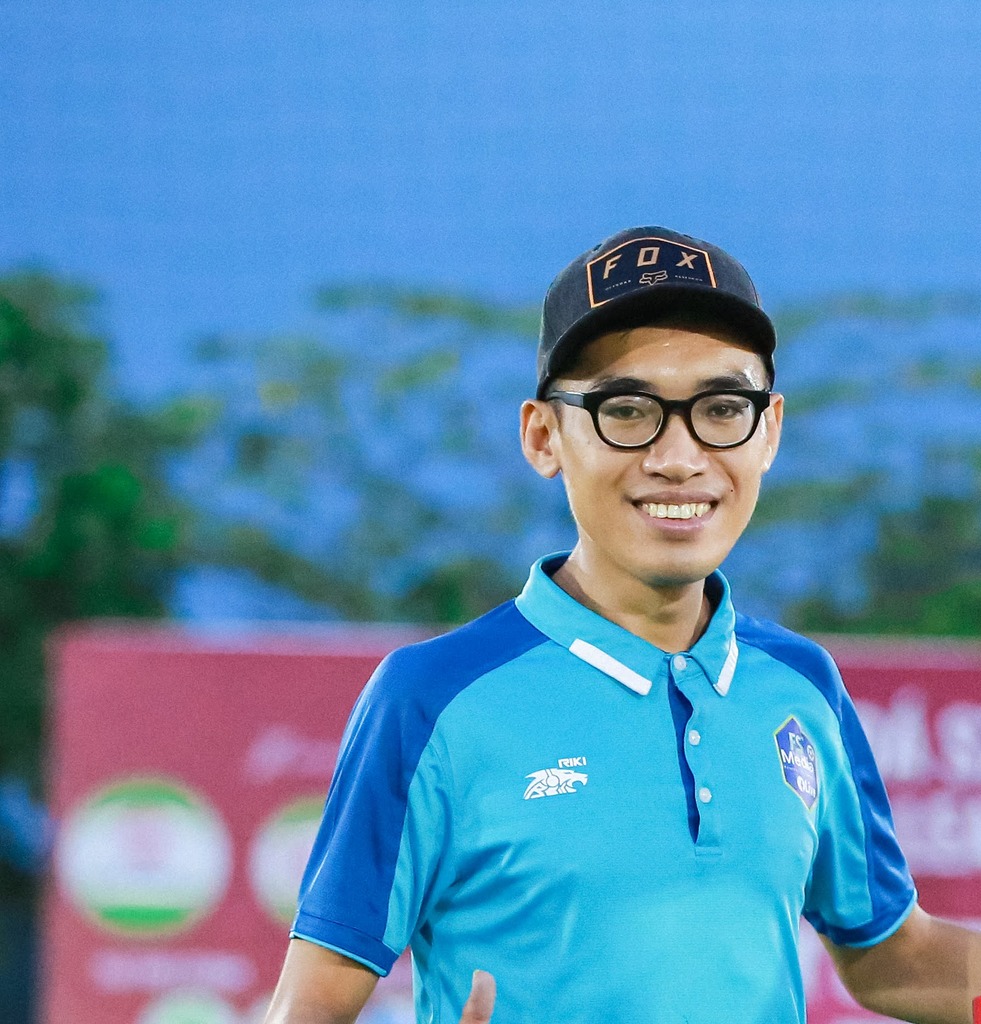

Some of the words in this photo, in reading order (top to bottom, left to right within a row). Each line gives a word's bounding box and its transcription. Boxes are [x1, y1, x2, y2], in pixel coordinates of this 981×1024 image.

[603, 247, 698, 280] FOX
[557, 756, 587, 769] RIKI
[780, 748, 814, 773] Media
